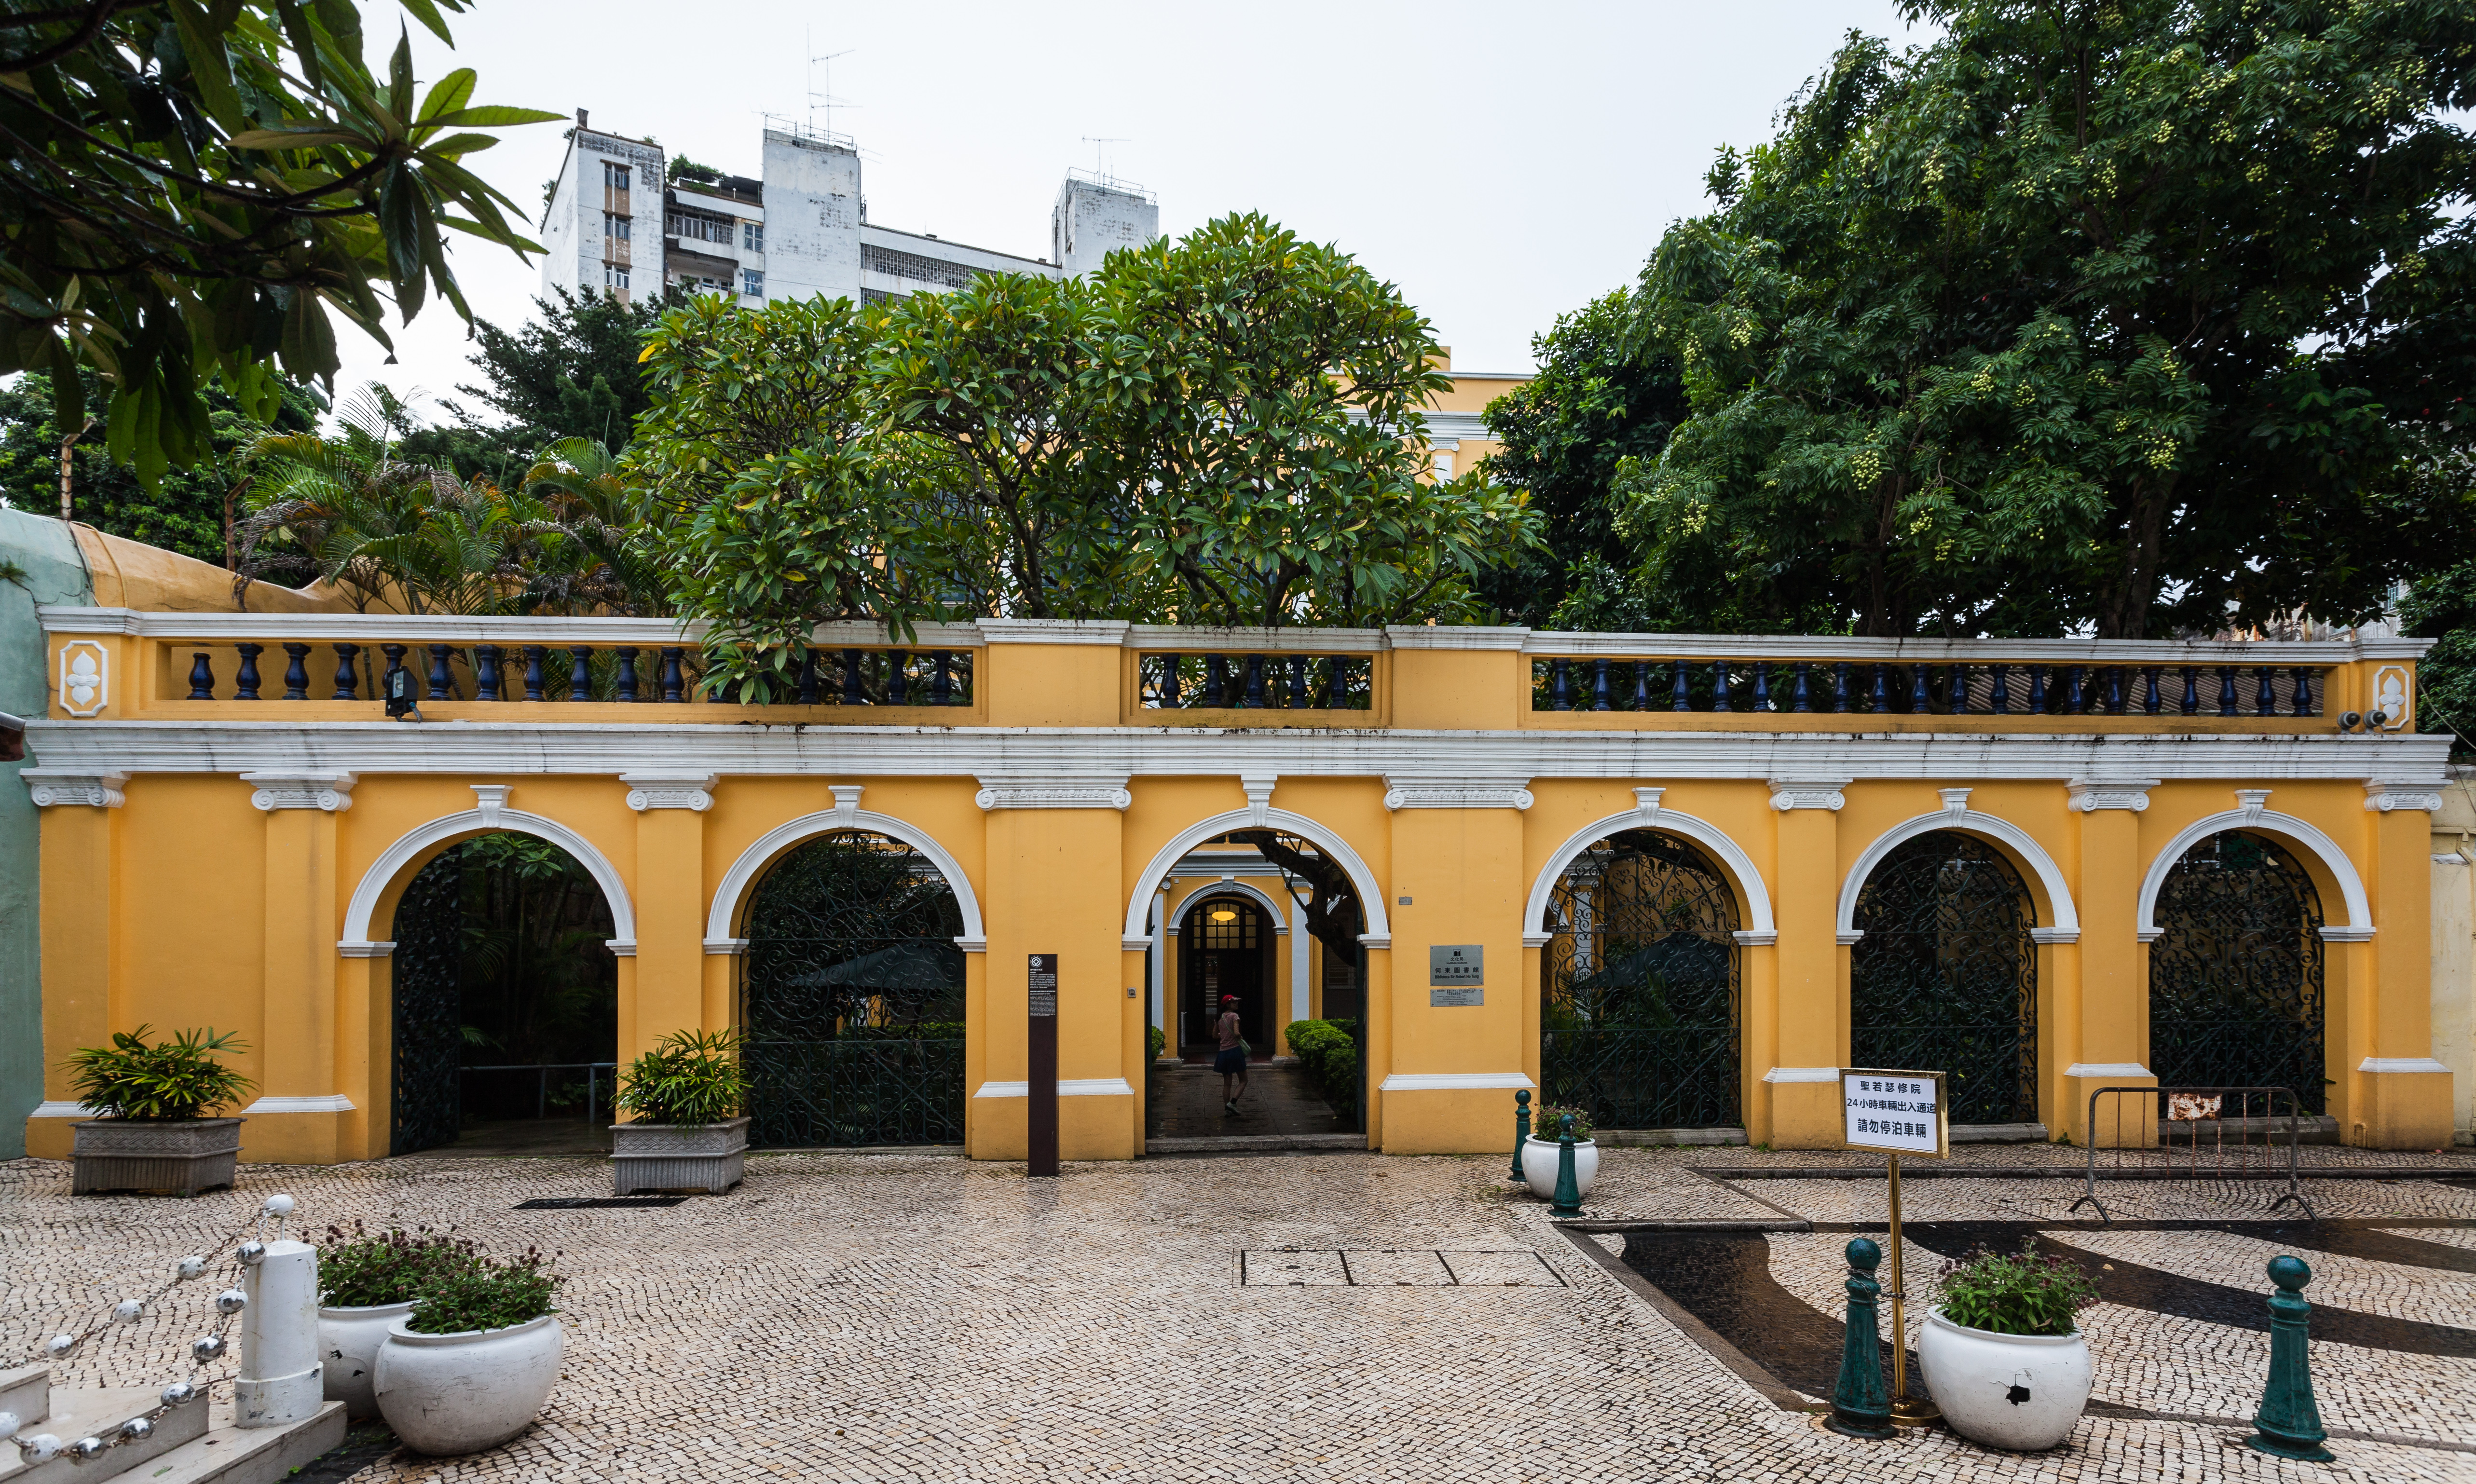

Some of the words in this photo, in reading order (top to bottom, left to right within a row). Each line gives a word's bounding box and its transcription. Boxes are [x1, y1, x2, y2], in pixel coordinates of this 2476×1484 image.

[1860, 1081, 1921, 1094] 聖若瑟修院
[1857, 1118, 1926, 1138] 請勿停泊車輛
